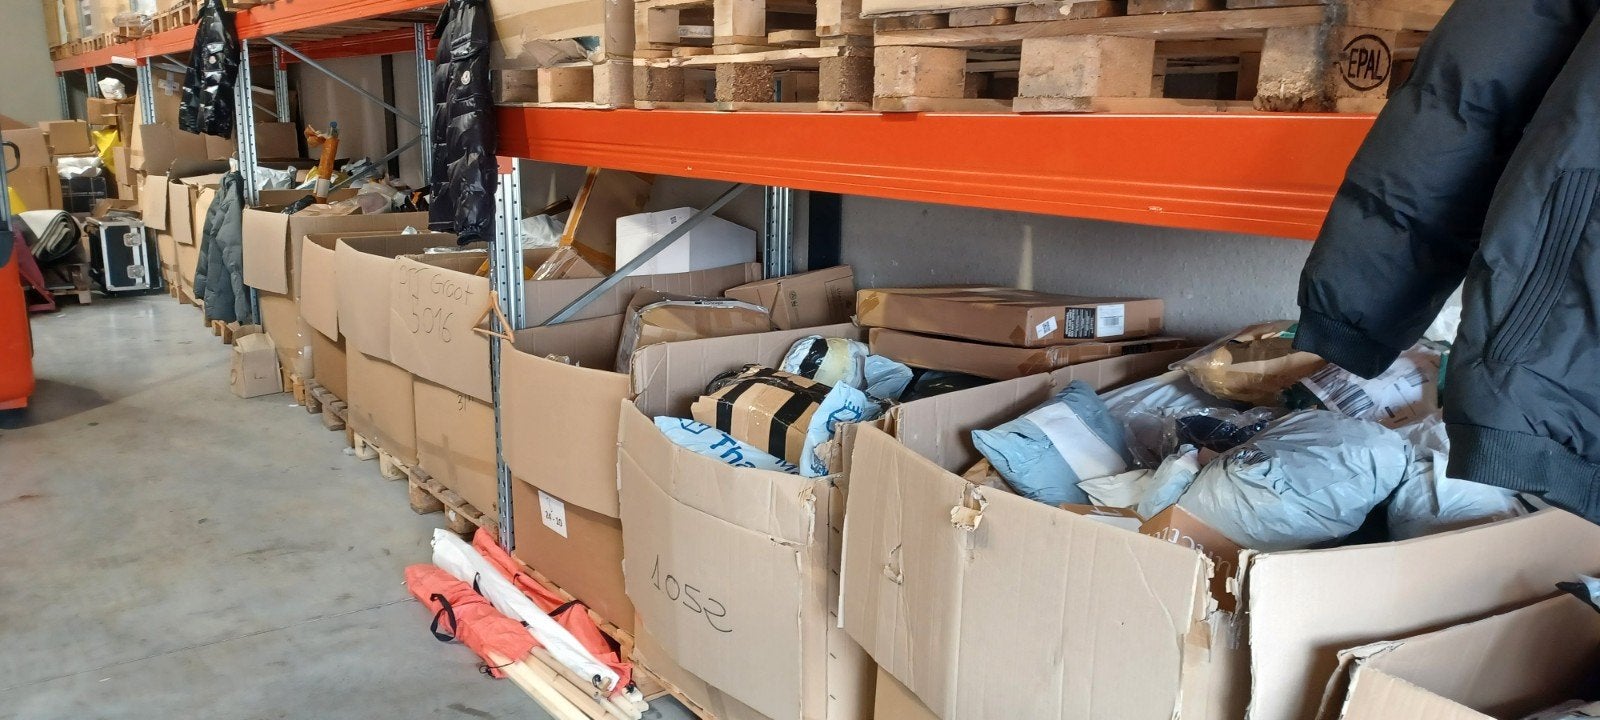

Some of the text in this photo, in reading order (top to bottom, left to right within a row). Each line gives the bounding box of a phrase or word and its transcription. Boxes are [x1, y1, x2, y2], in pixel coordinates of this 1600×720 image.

[1347, 47, 1384, 80] EPAL
[409, 294, 454, 343] 5016
[651, 554, 733, 633] 1052
